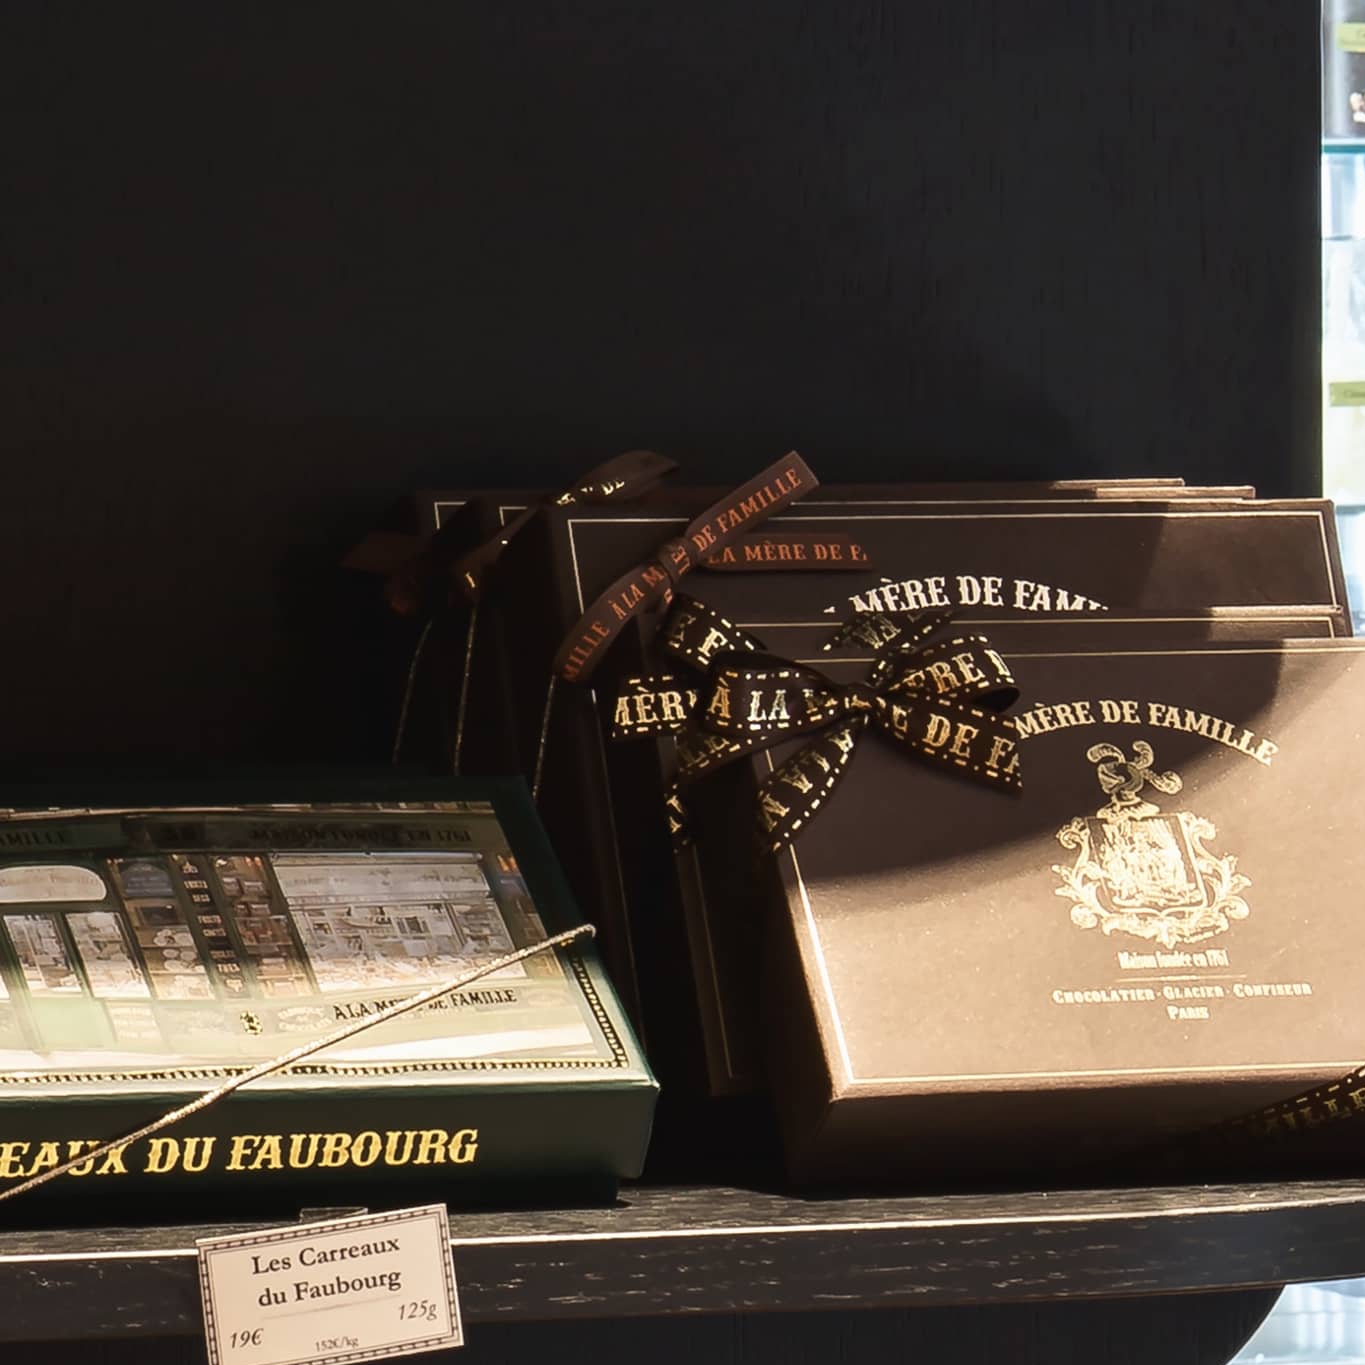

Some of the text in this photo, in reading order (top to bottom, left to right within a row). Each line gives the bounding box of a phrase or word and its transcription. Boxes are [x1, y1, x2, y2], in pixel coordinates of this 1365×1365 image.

[718, 468, 802, 533] FAMILLE
[814, 543, 843, 561] DE
[956, 575, 1003, 607] DE
[748, 689, 791, 722] LA
[923, 712, 978, 758] DE
[1101, 700, 1141, 724] DE
[1149, 702, 1280, 767] FAMILLE
[450, 989, 518, 1008] FAMILLE
[143, 1136, 217, 1173] DU
[226, 1129, 480, 1172] FAUBOURG
[252, 1238, 401, 1276] Les Carreaux
[258, 1270, 402, 1308] du Faubourg
[398, 1300, 438, 1321] 125g
[230, 1328, 264, 1349] 19€
